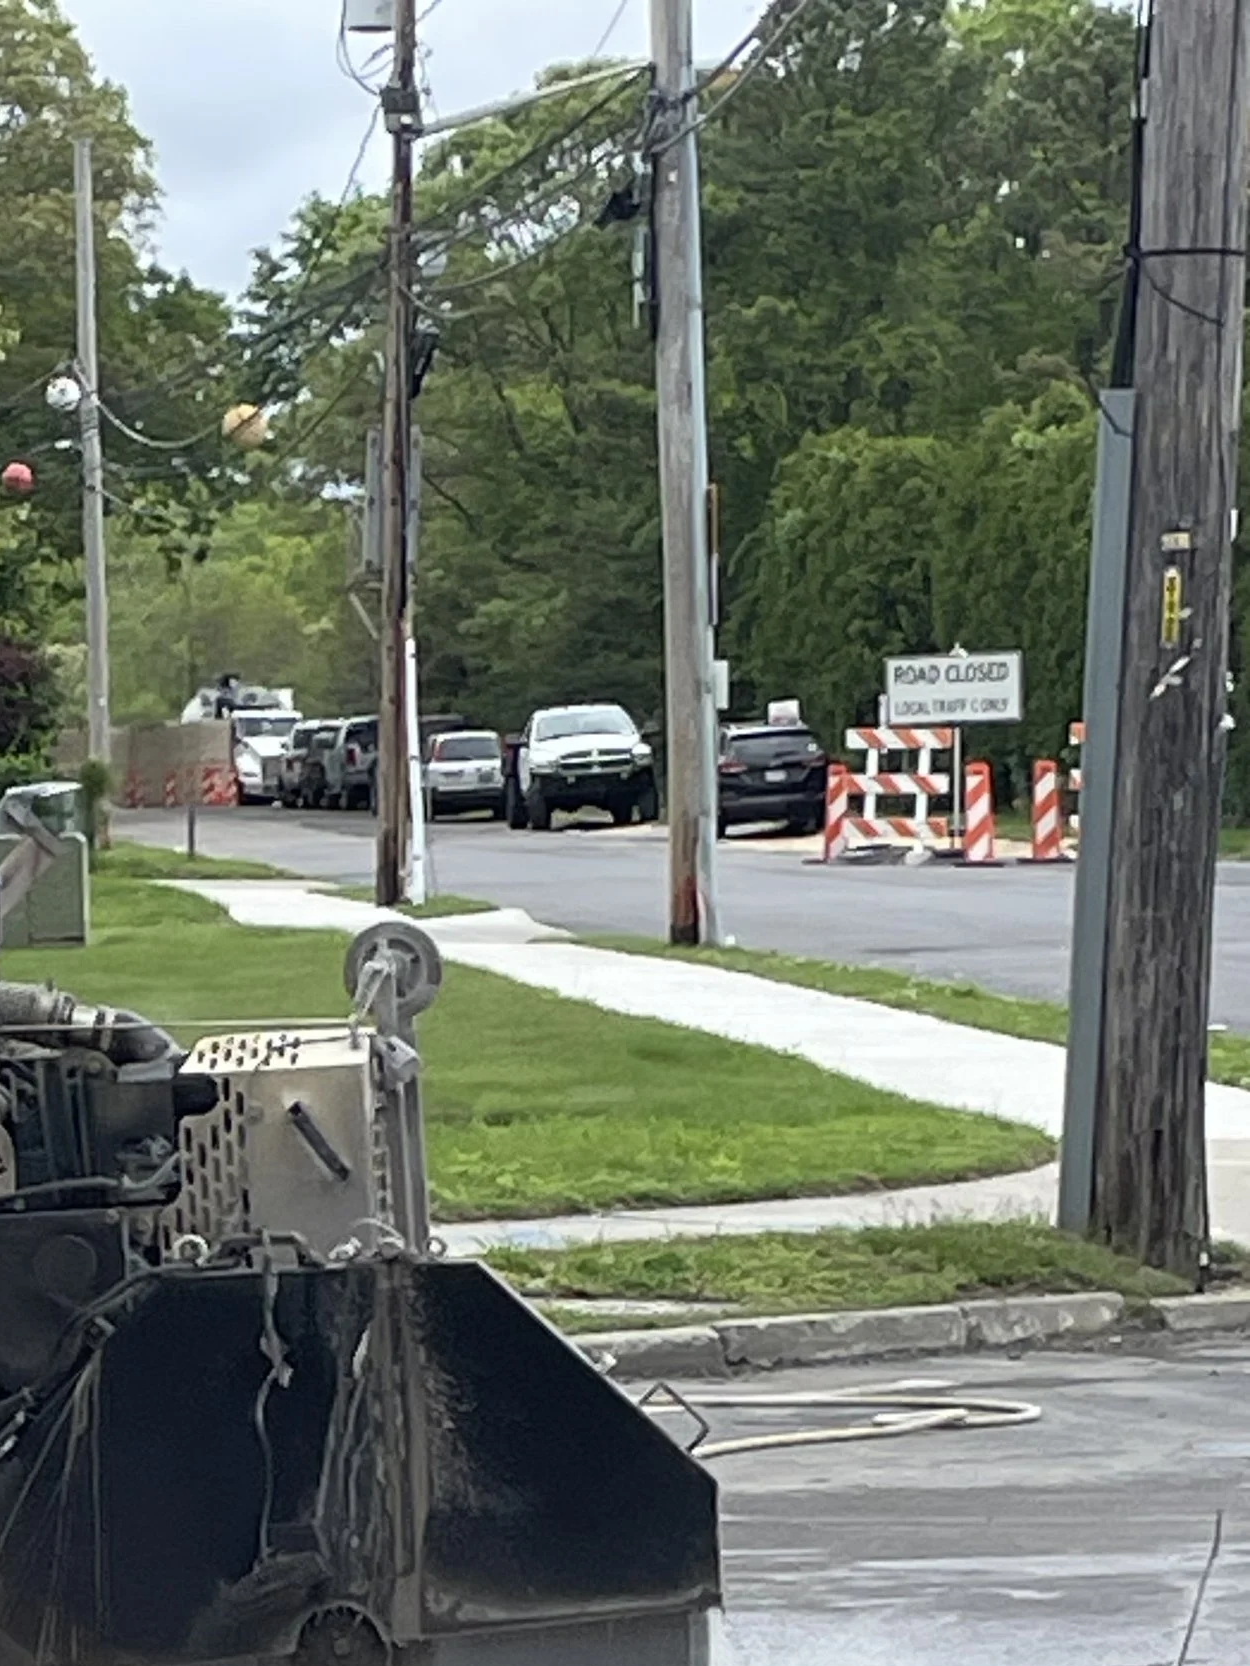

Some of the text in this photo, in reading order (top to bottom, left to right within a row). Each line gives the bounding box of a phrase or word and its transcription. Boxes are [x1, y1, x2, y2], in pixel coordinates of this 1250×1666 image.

[894, 661, 1010, 685] ROAD CLOSED
[894, 700, 931, 716] LOCAL
